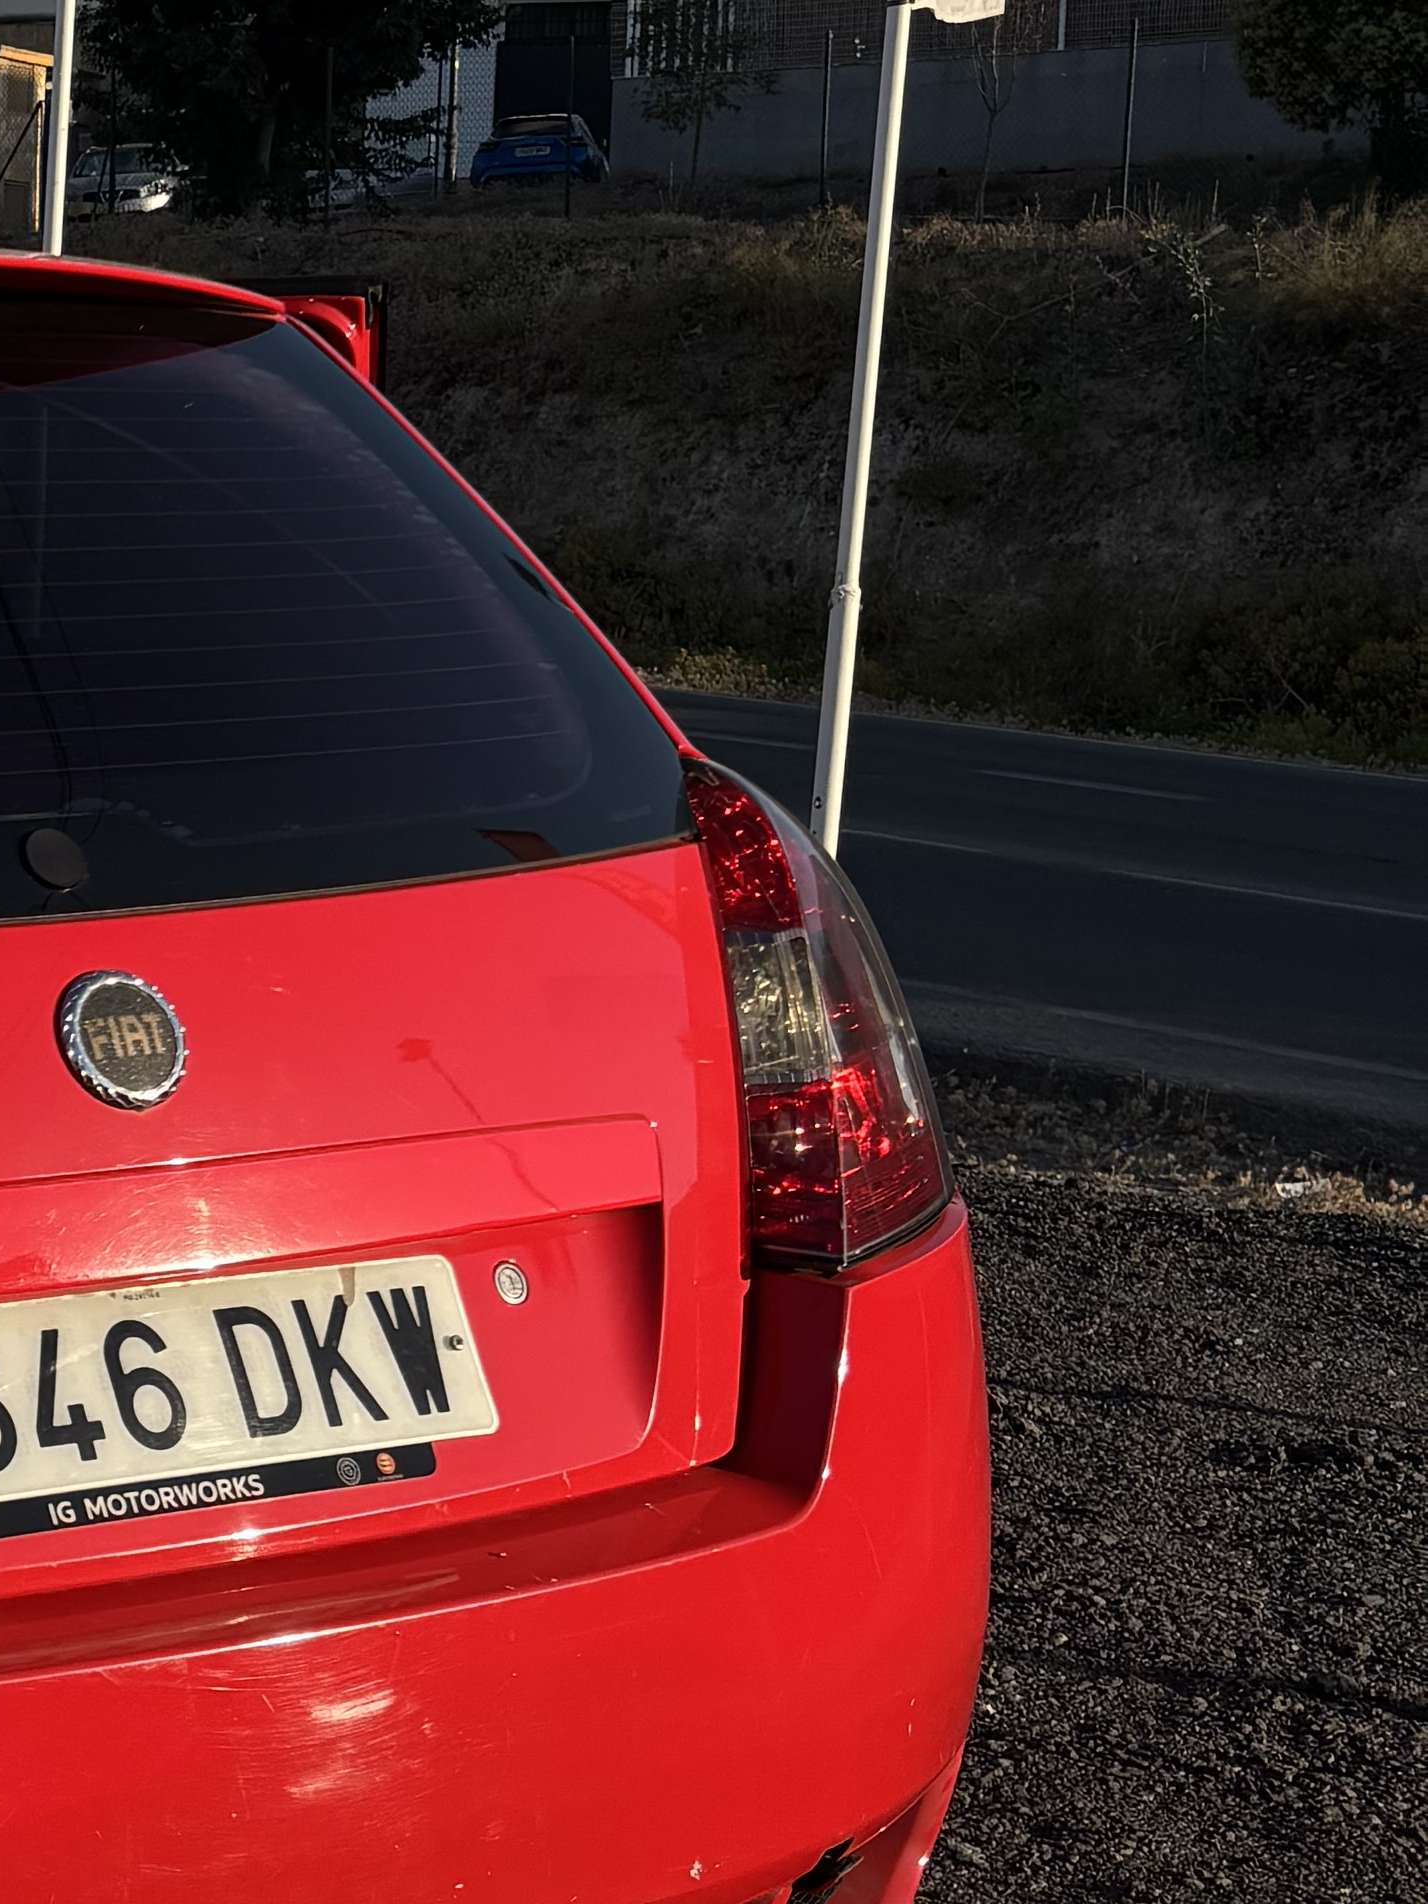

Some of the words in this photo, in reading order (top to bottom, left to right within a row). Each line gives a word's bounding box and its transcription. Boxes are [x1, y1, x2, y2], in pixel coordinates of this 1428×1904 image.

[83, 1012, 166, 1060] FIAT
[213, 1284, 451, 1441] DKW
[48, 1502, 76, 1525] IG
[84, 1473, 265, 1520] MOTORWORKS
